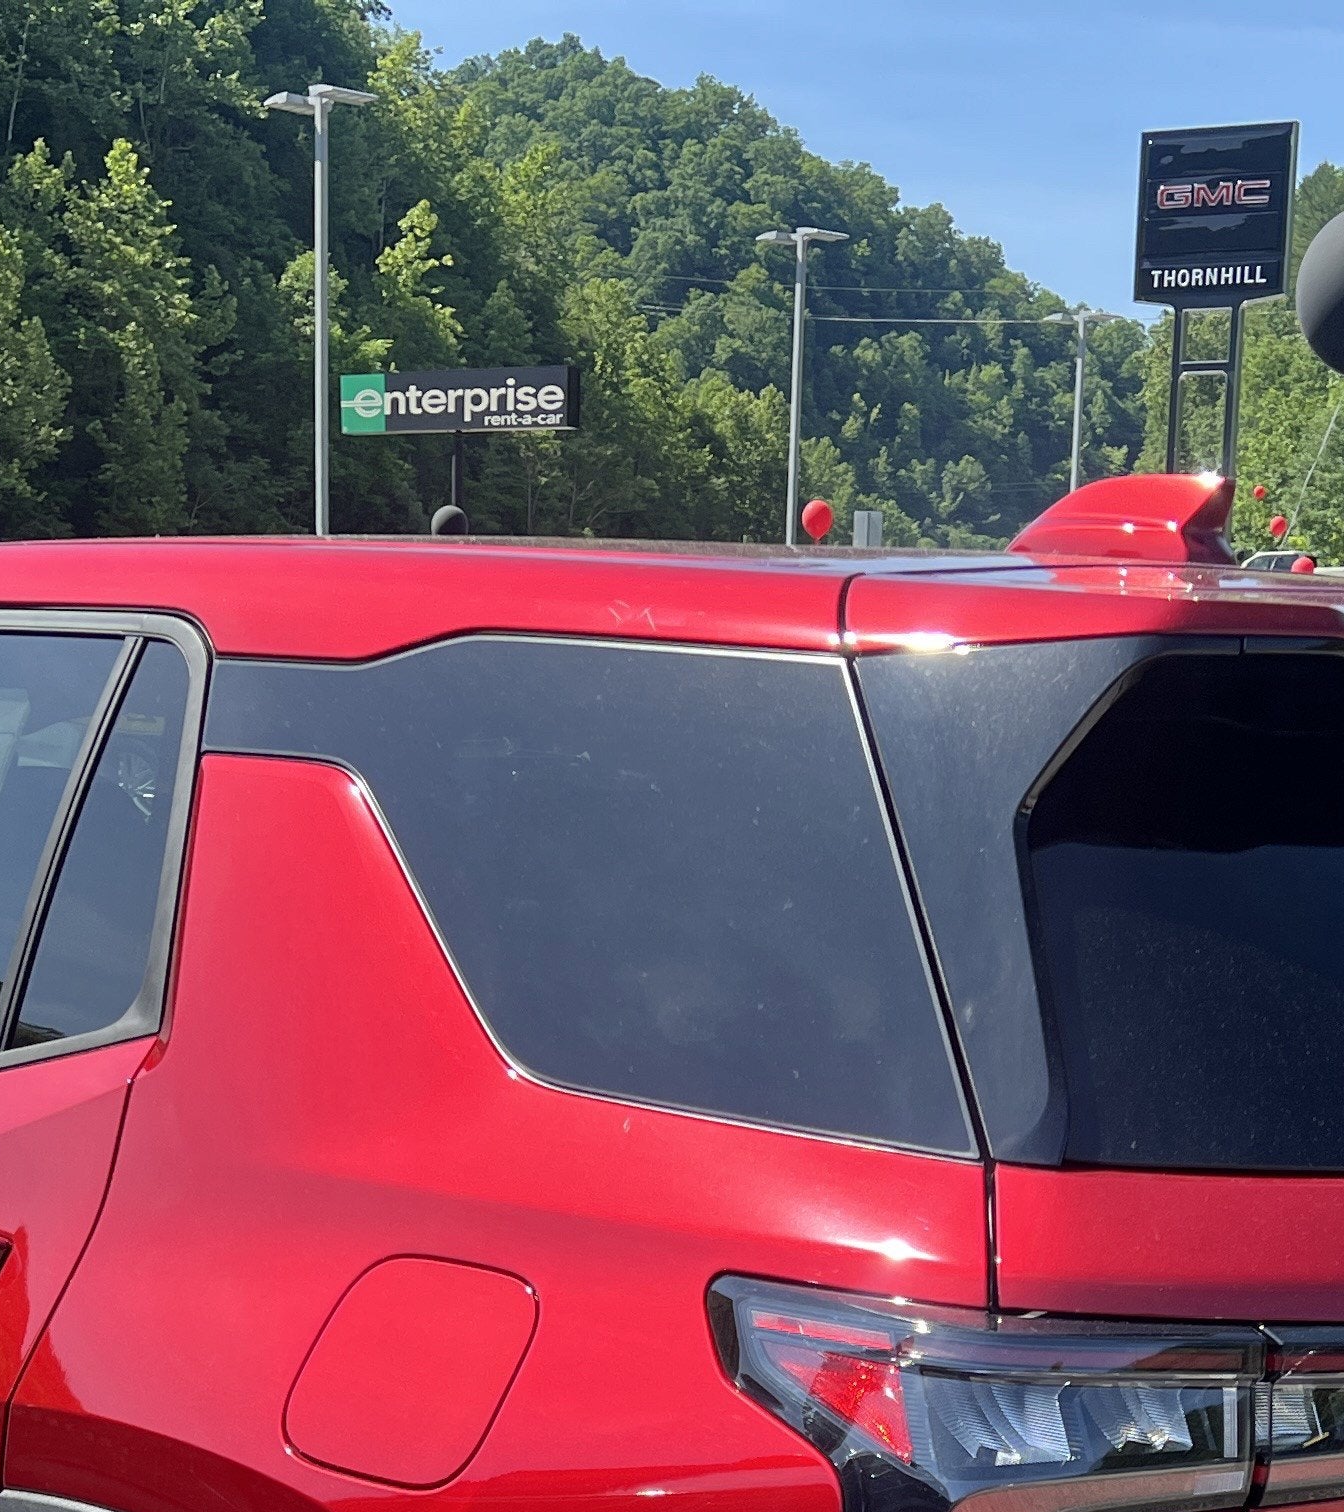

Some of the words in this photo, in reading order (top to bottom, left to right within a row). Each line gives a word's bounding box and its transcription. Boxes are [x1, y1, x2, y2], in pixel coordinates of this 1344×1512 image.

[1157, 179, 1271, 210] GMC
[1151, 265, 1267, 288] THORNHILL
[353, 377, 565, 422] enterprise
[484, 412, 564, 426] rent-a-car
